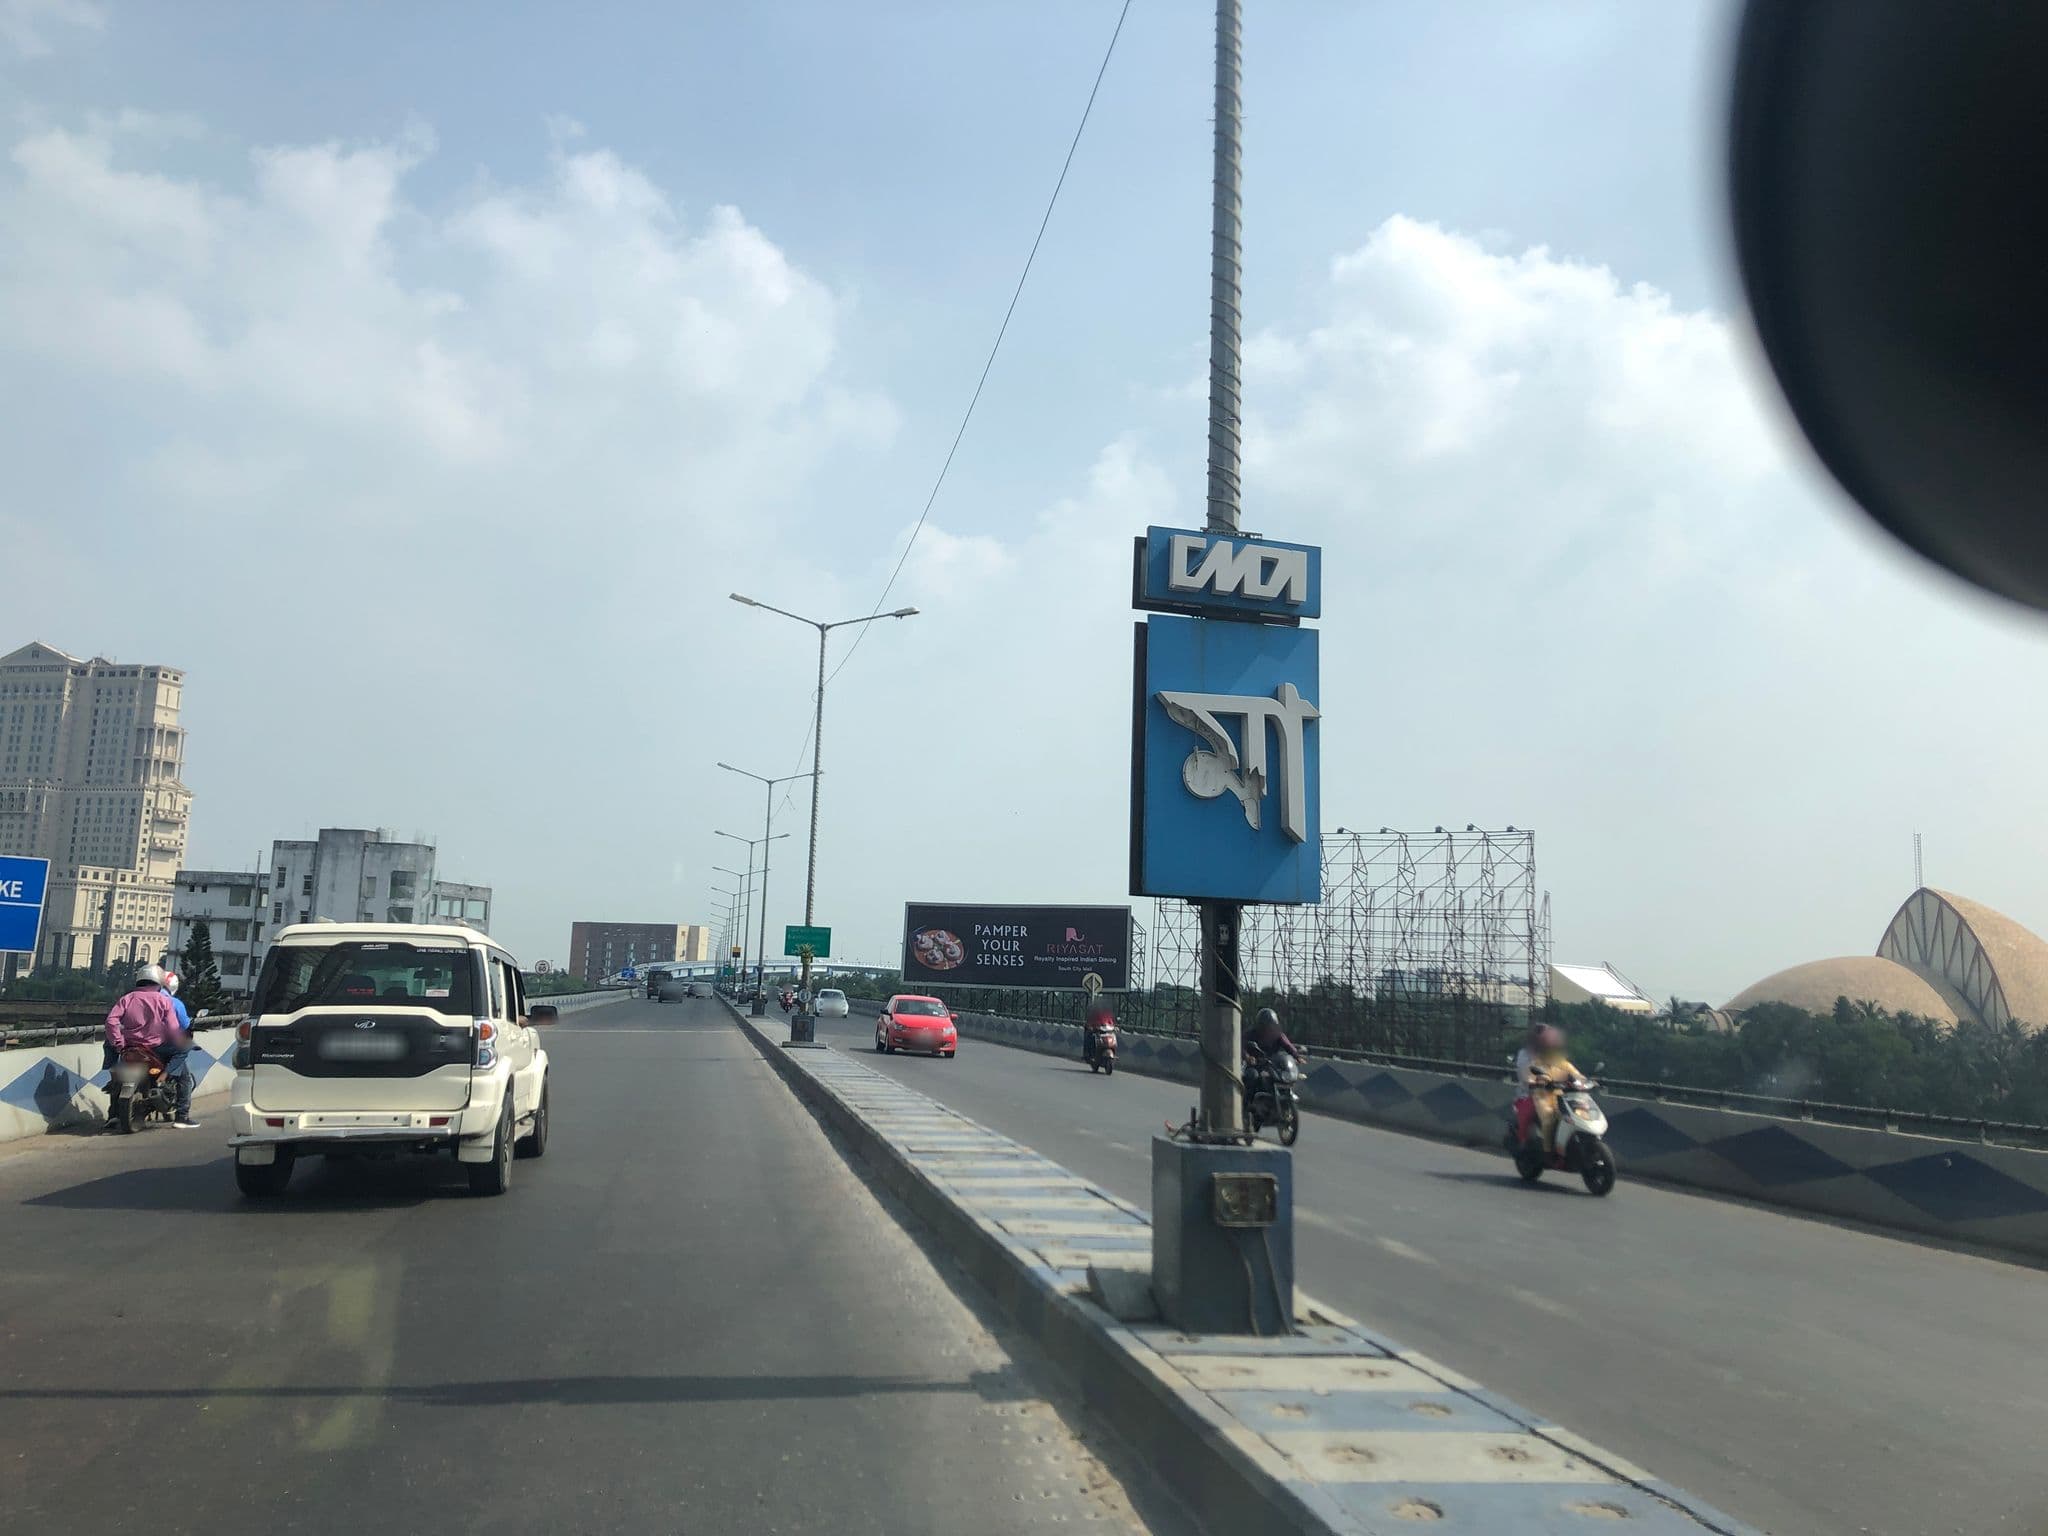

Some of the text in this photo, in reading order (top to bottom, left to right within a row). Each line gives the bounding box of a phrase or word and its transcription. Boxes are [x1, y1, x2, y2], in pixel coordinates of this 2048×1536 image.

[974, 924, 1028, 937] PAMPER
[981, 939, 1020, 951] YOUR
[1046, 943, 1104, 954] RIYASAT
[976, 953, 1024, 967] SENSES
